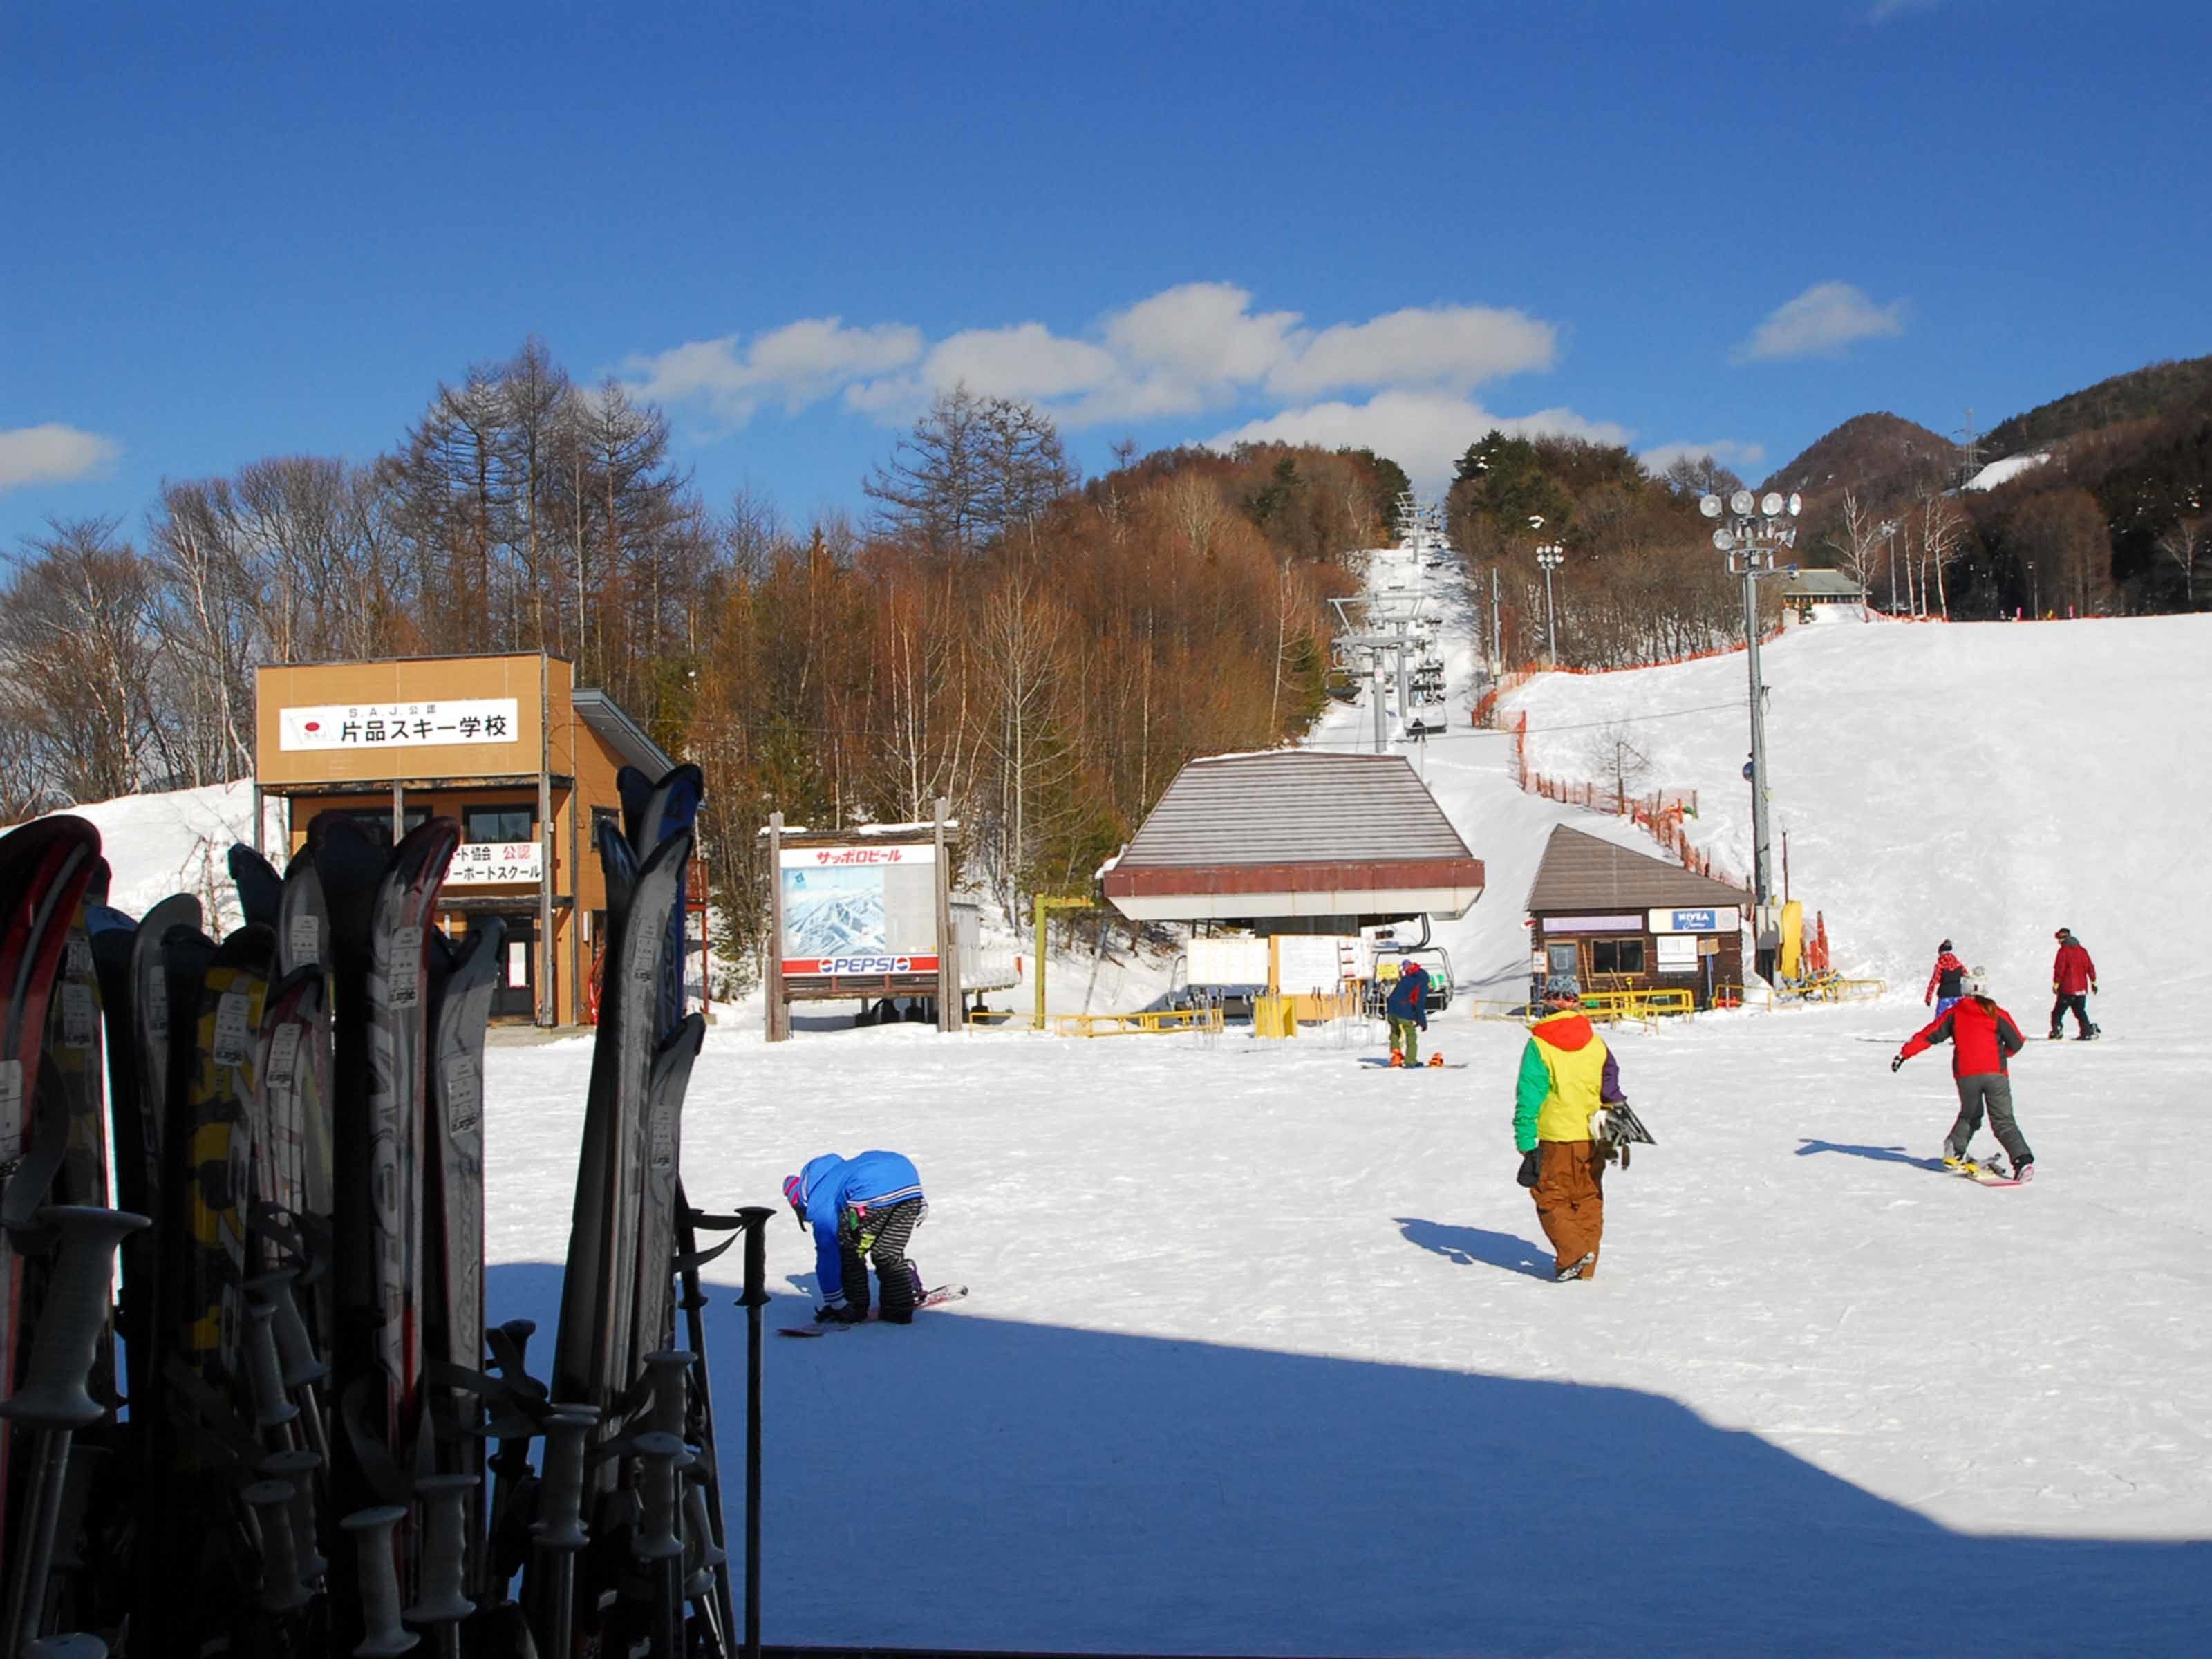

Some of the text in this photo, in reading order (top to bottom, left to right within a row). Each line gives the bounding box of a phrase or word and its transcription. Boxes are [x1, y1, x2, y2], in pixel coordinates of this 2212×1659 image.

[341, 714, 507, 743] 片品スキー学校
[816, 849, 903, 865] サッポロビール
[1678, 912, 1710, 921] NIVEA
[834, 957, 896, 973] PEPSI
